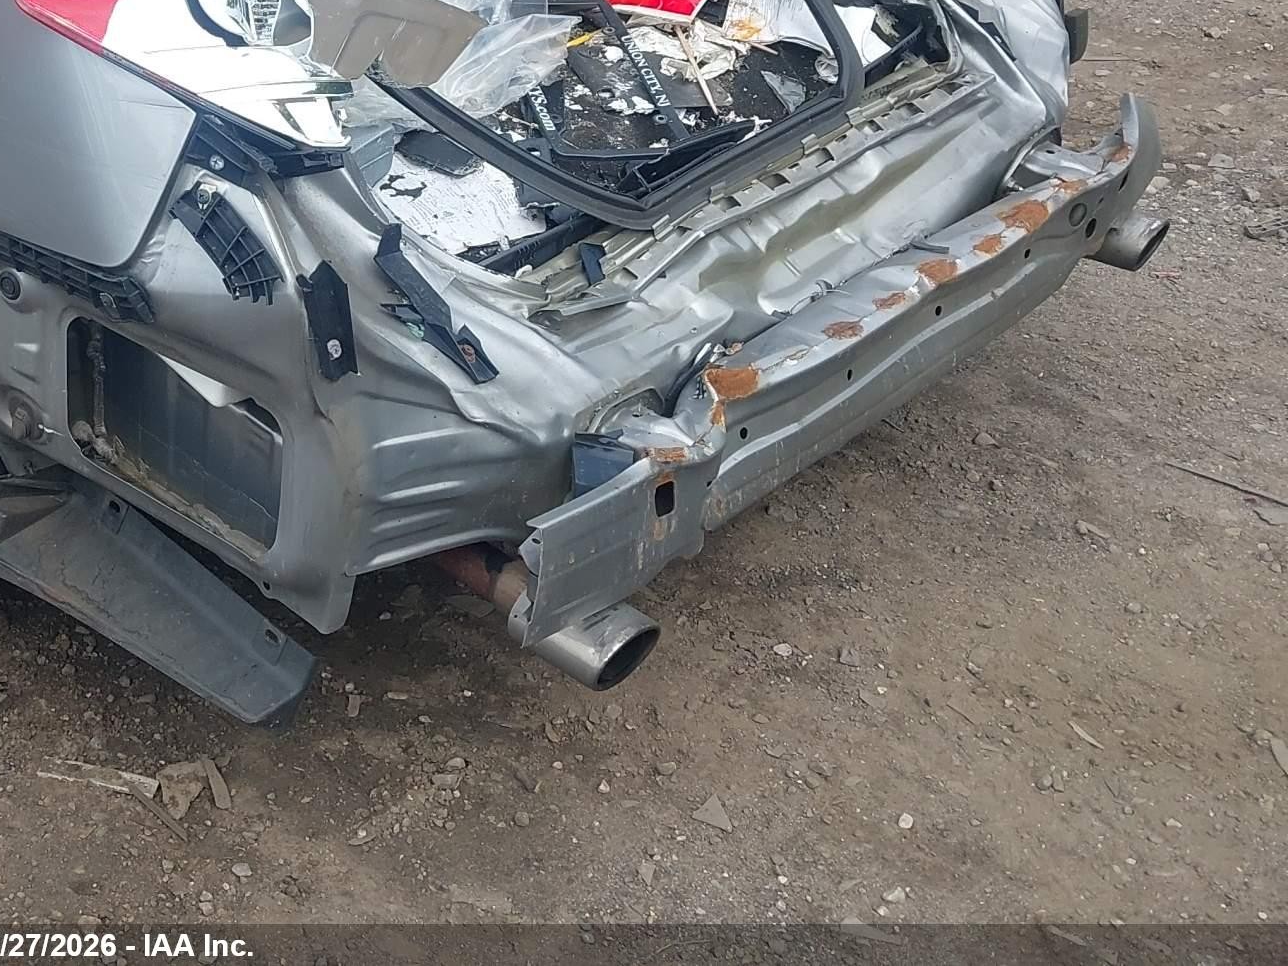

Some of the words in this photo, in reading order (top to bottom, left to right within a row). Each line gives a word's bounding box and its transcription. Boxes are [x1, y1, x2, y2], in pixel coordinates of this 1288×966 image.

[621, 34, 649, 68] UNION
[640, 68, 664, 94] CITY,
[655, 94, 672, 107] NJ
